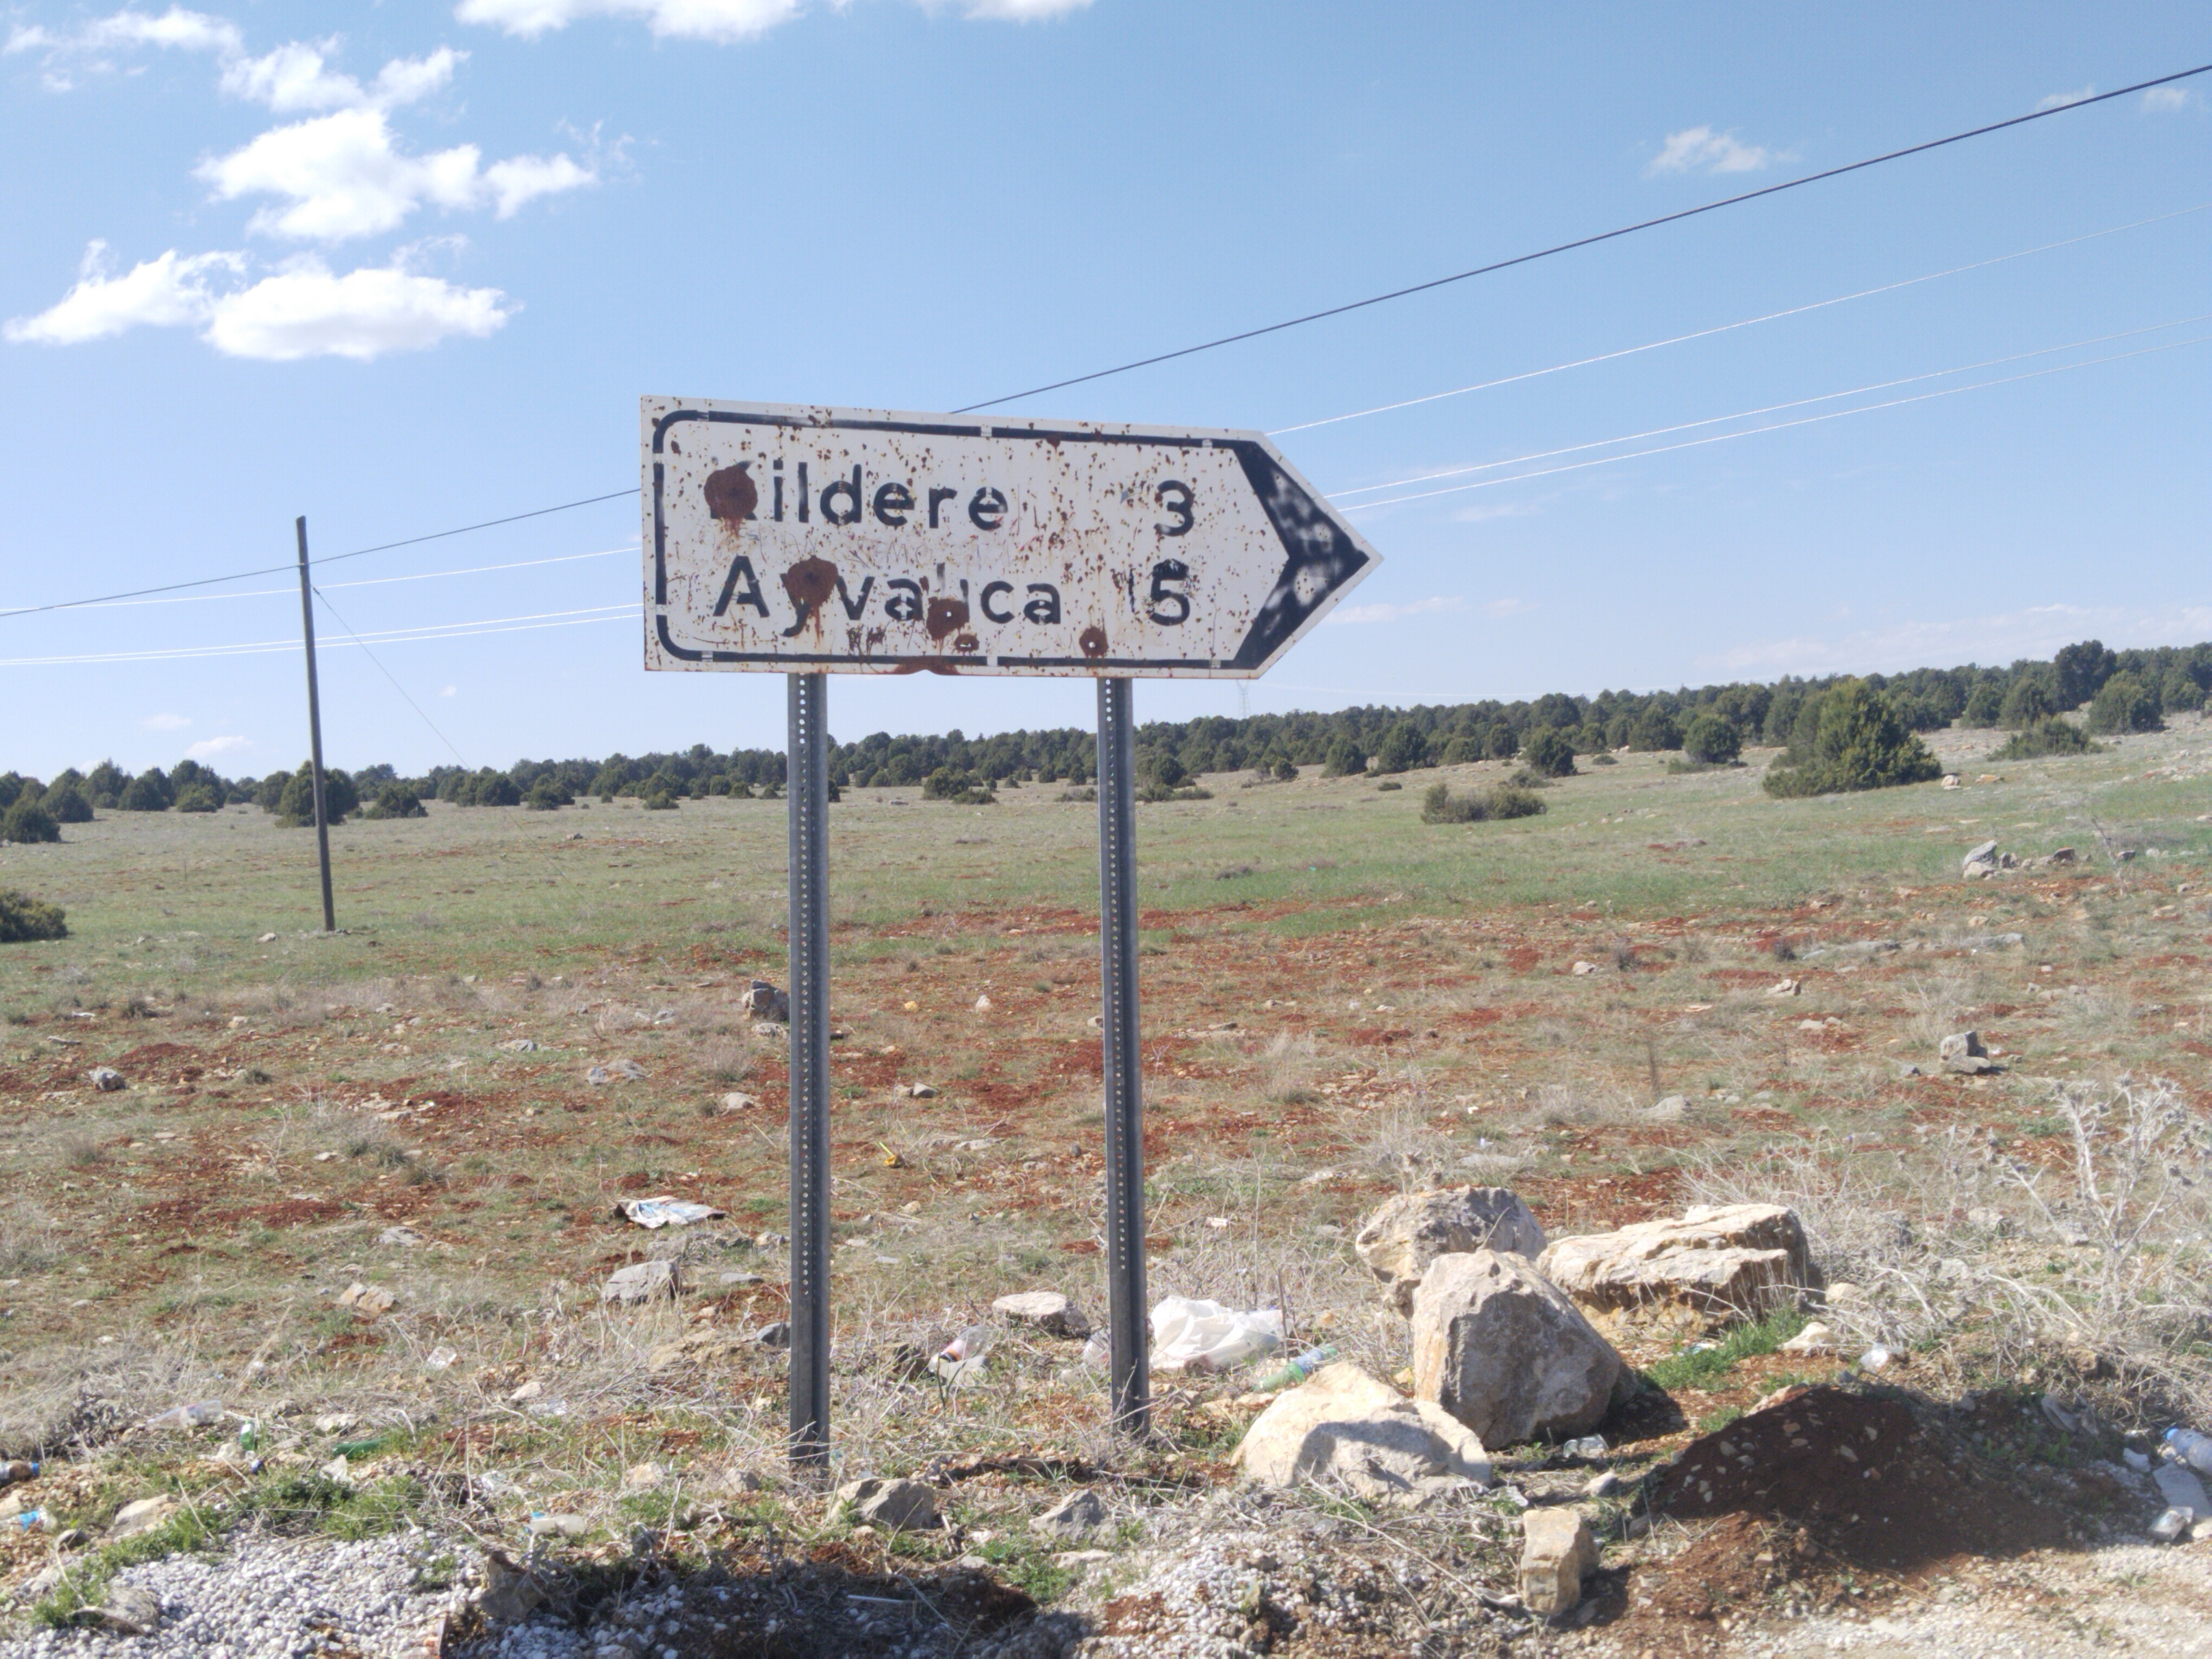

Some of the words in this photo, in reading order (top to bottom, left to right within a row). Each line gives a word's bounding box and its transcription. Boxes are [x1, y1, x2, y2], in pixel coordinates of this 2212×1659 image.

[708, 460, 1008, 531] ildere
[1154, 480, 1194, 537] 3
[1148, 559, 1190, 626] 5
